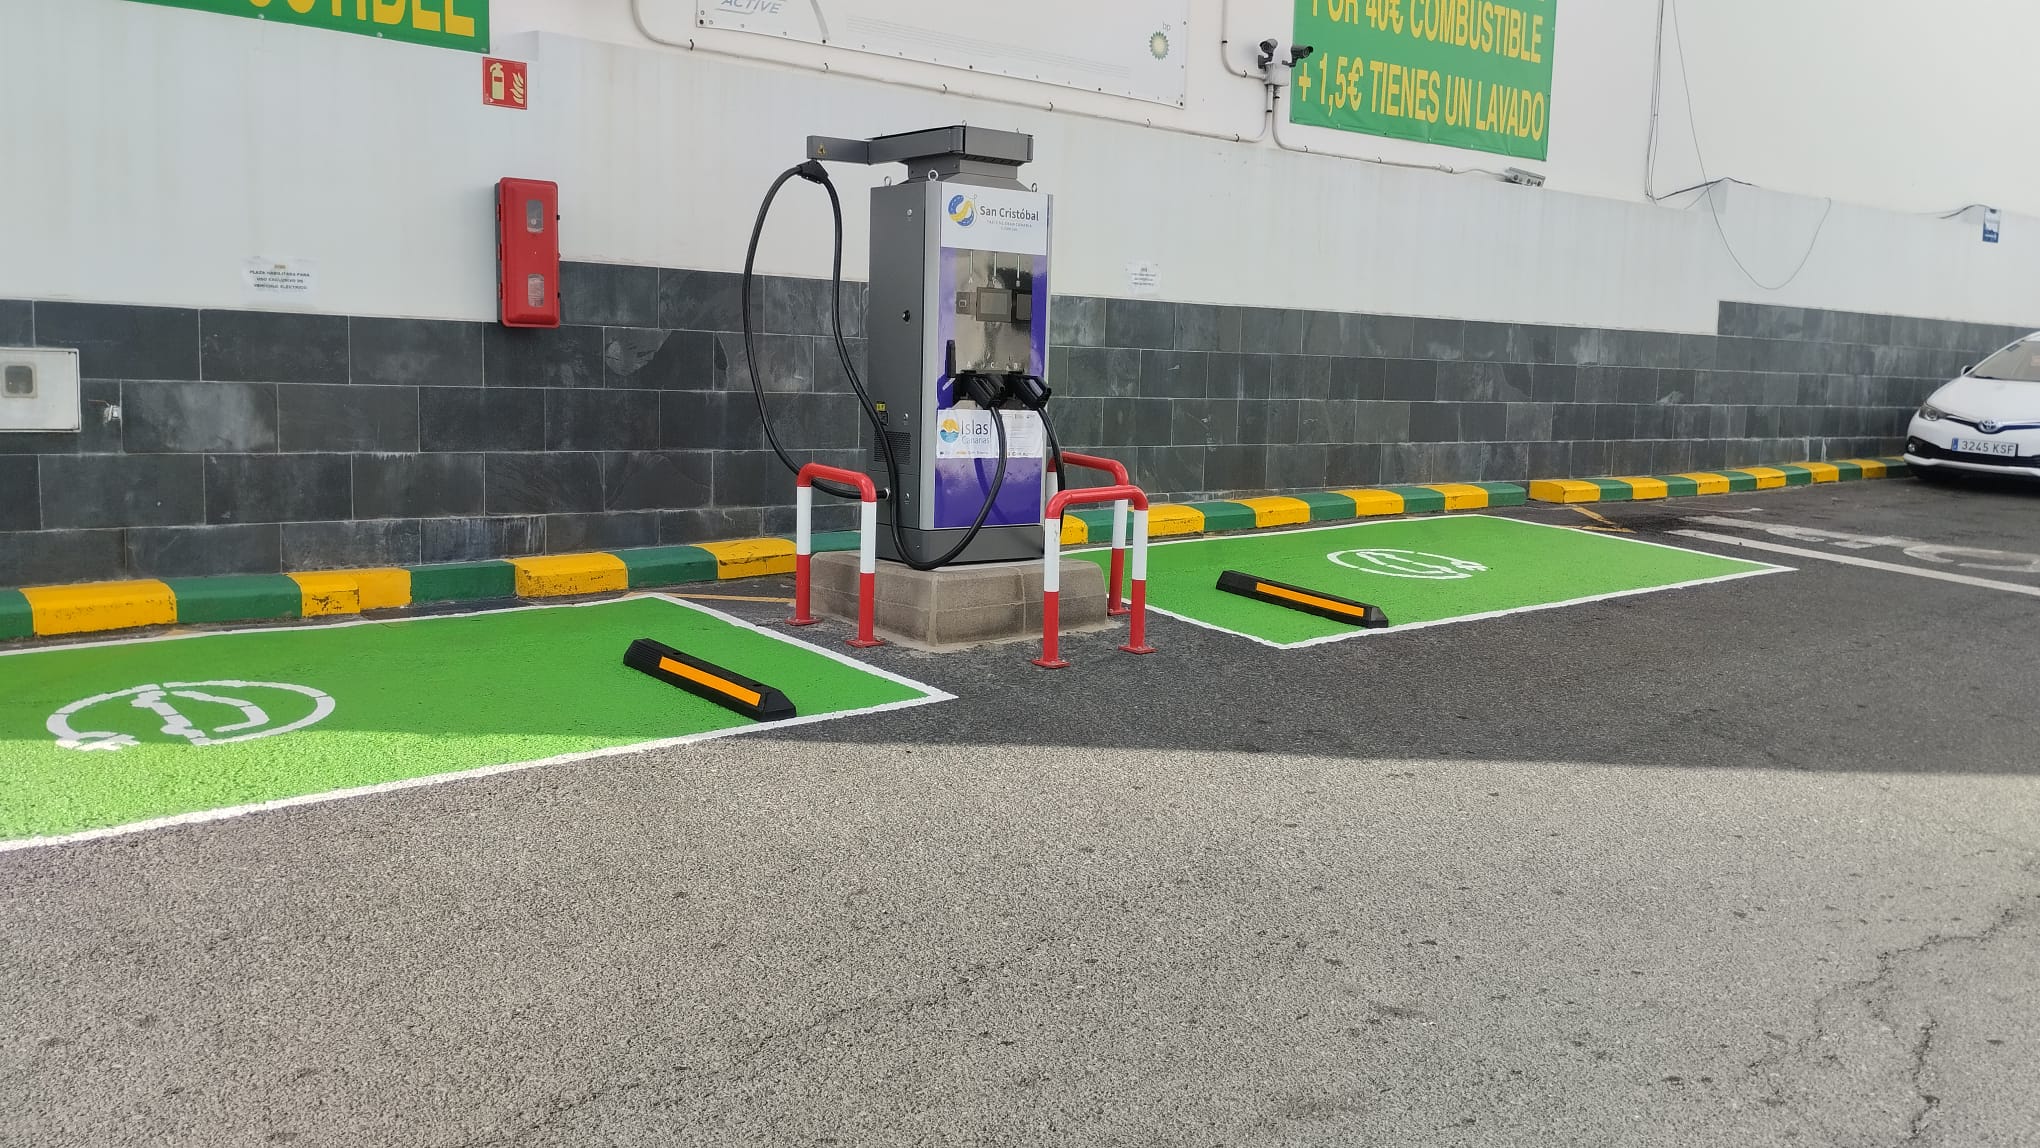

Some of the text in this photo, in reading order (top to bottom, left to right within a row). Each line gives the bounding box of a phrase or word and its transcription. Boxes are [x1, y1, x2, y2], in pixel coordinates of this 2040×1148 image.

[1409, 0, 1544, 63] COMBUSTIBLE
[1319, 53, 1364, 117] 1,5€
[1369, 60, 1440, 124] TIENES
[1445, 75, 1472, 128] UN
[1475, 80, 1545, 142] LAVADO
[980, 205, 1039, 221] San Cristóbal
[961, 419, 989, 435] Islas
[1962, 440, 2014, 455] 3245 KSF
